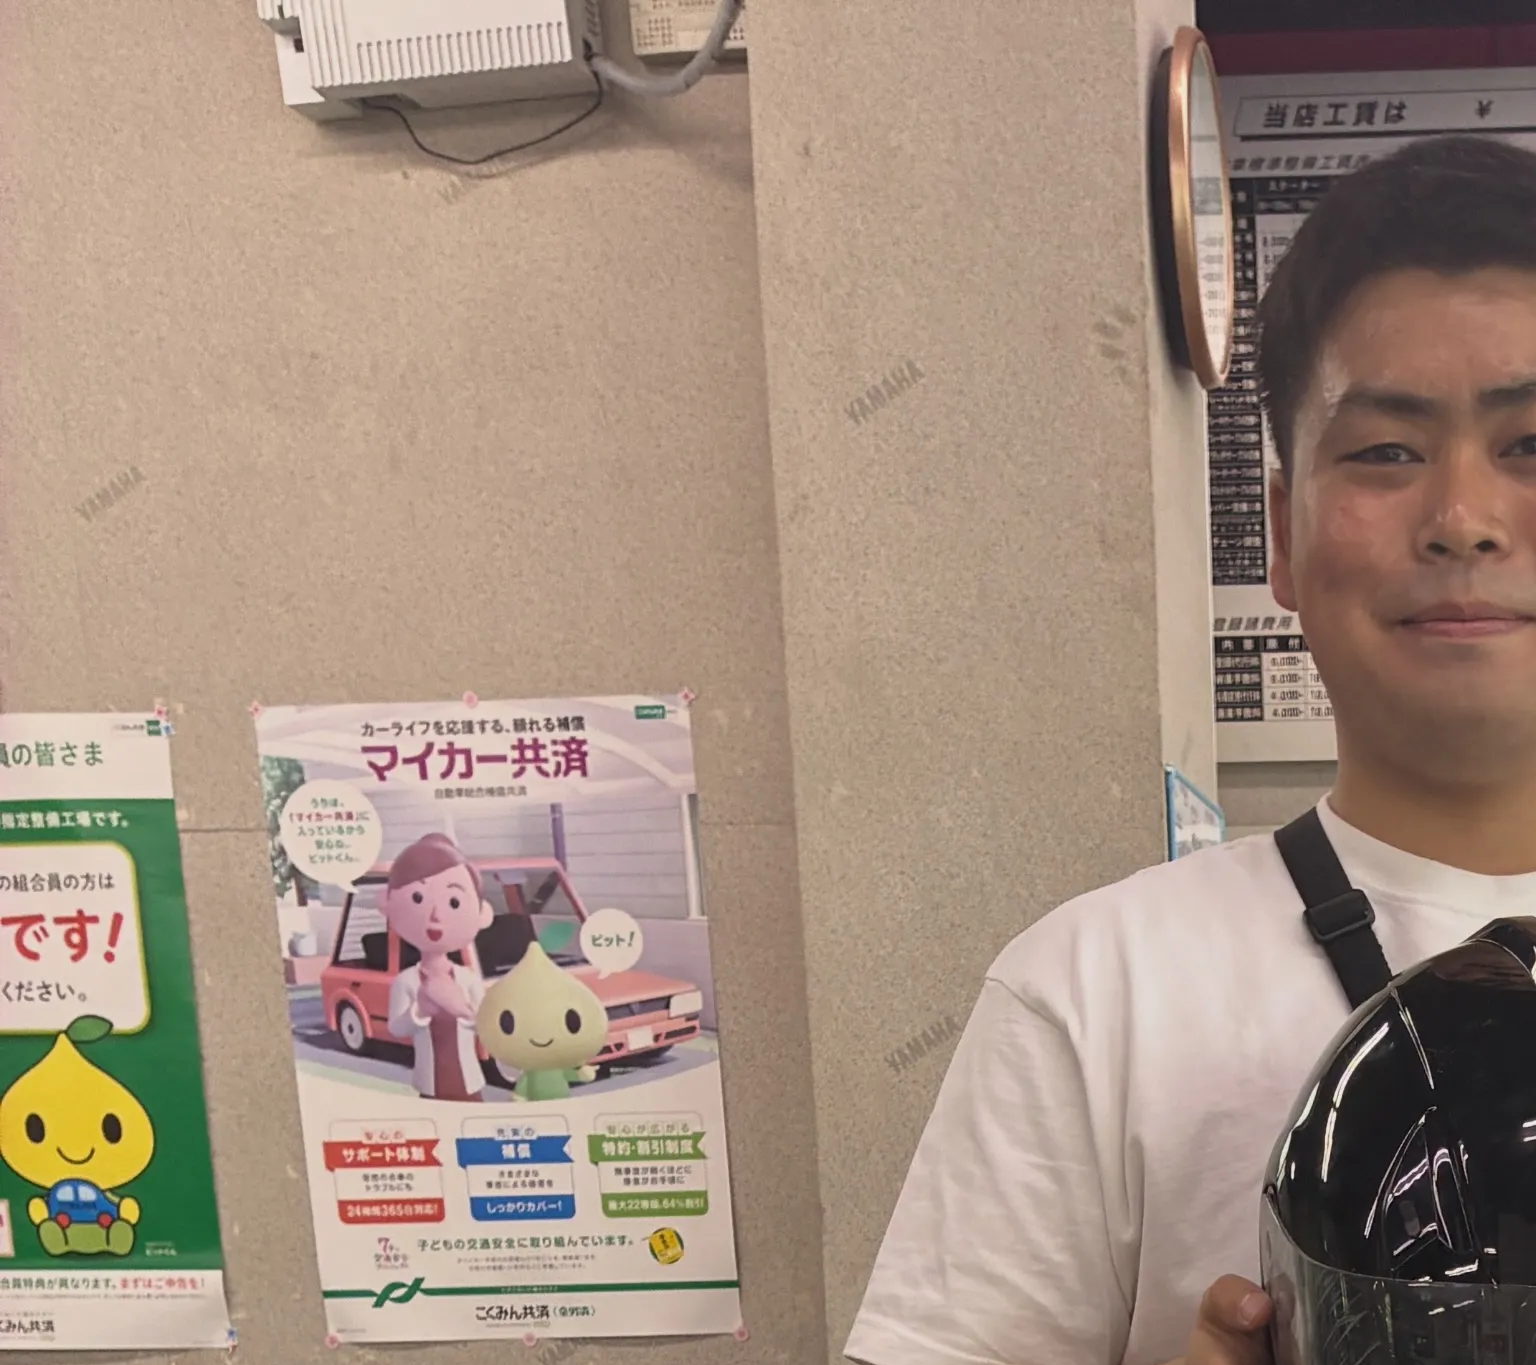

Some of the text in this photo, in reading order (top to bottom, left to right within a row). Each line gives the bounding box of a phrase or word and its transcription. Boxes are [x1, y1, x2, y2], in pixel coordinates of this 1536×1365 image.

[1263, 101, 1407, 128] 当店工賃は
[844, 360, 926, 425] YAMAHA
[74, 466, 148, 523] YAMAHA
[361, 736, 589, 782] マイカー共済
[884, 1016, 963, 1073] YAMAHA
[475, 1304, 549, 1321] こくみん共済
